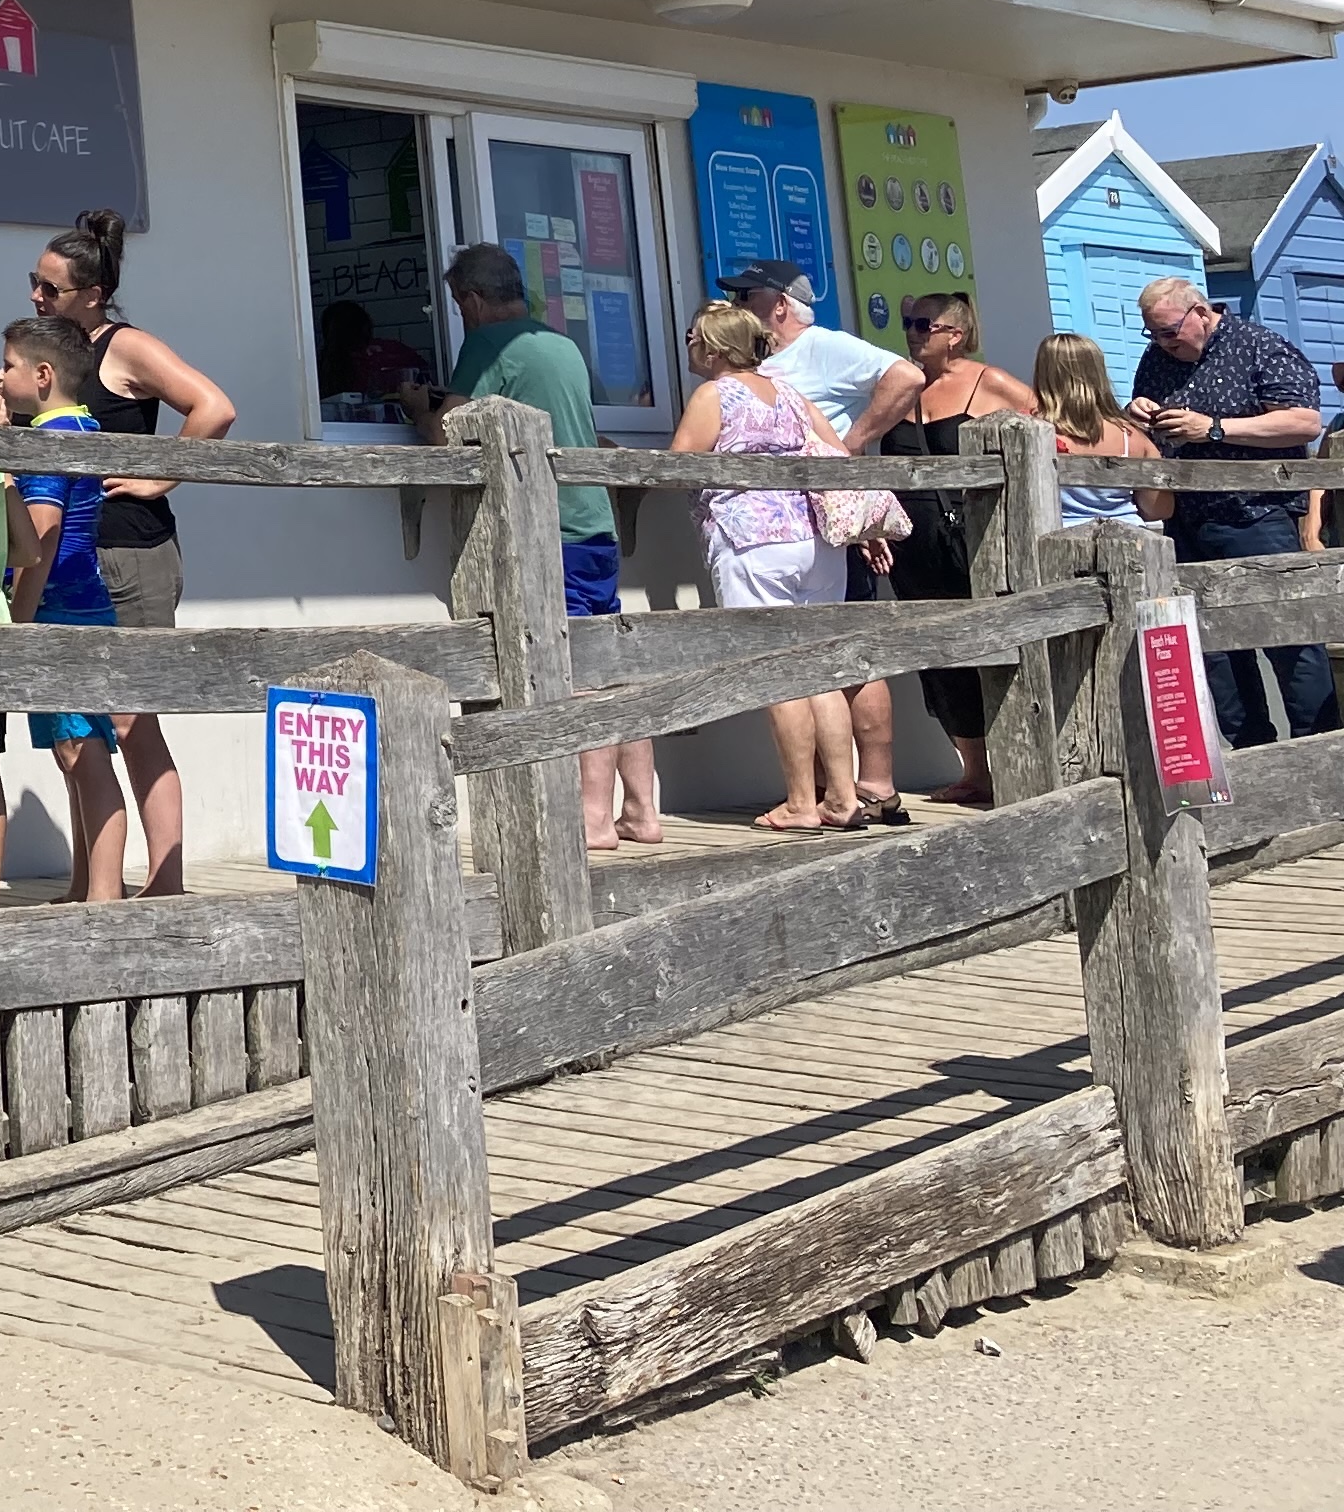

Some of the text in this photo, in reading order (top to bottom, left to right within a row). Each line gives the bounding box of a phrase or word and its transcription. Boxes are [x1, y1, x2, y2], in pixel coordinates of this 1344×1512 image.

[31, 120, 92, 156] CAFE
[279, 711, 364, 743] ENTRY
[291, 739, 351, 769] THIS
[294, 767, 350, 796] WAY
